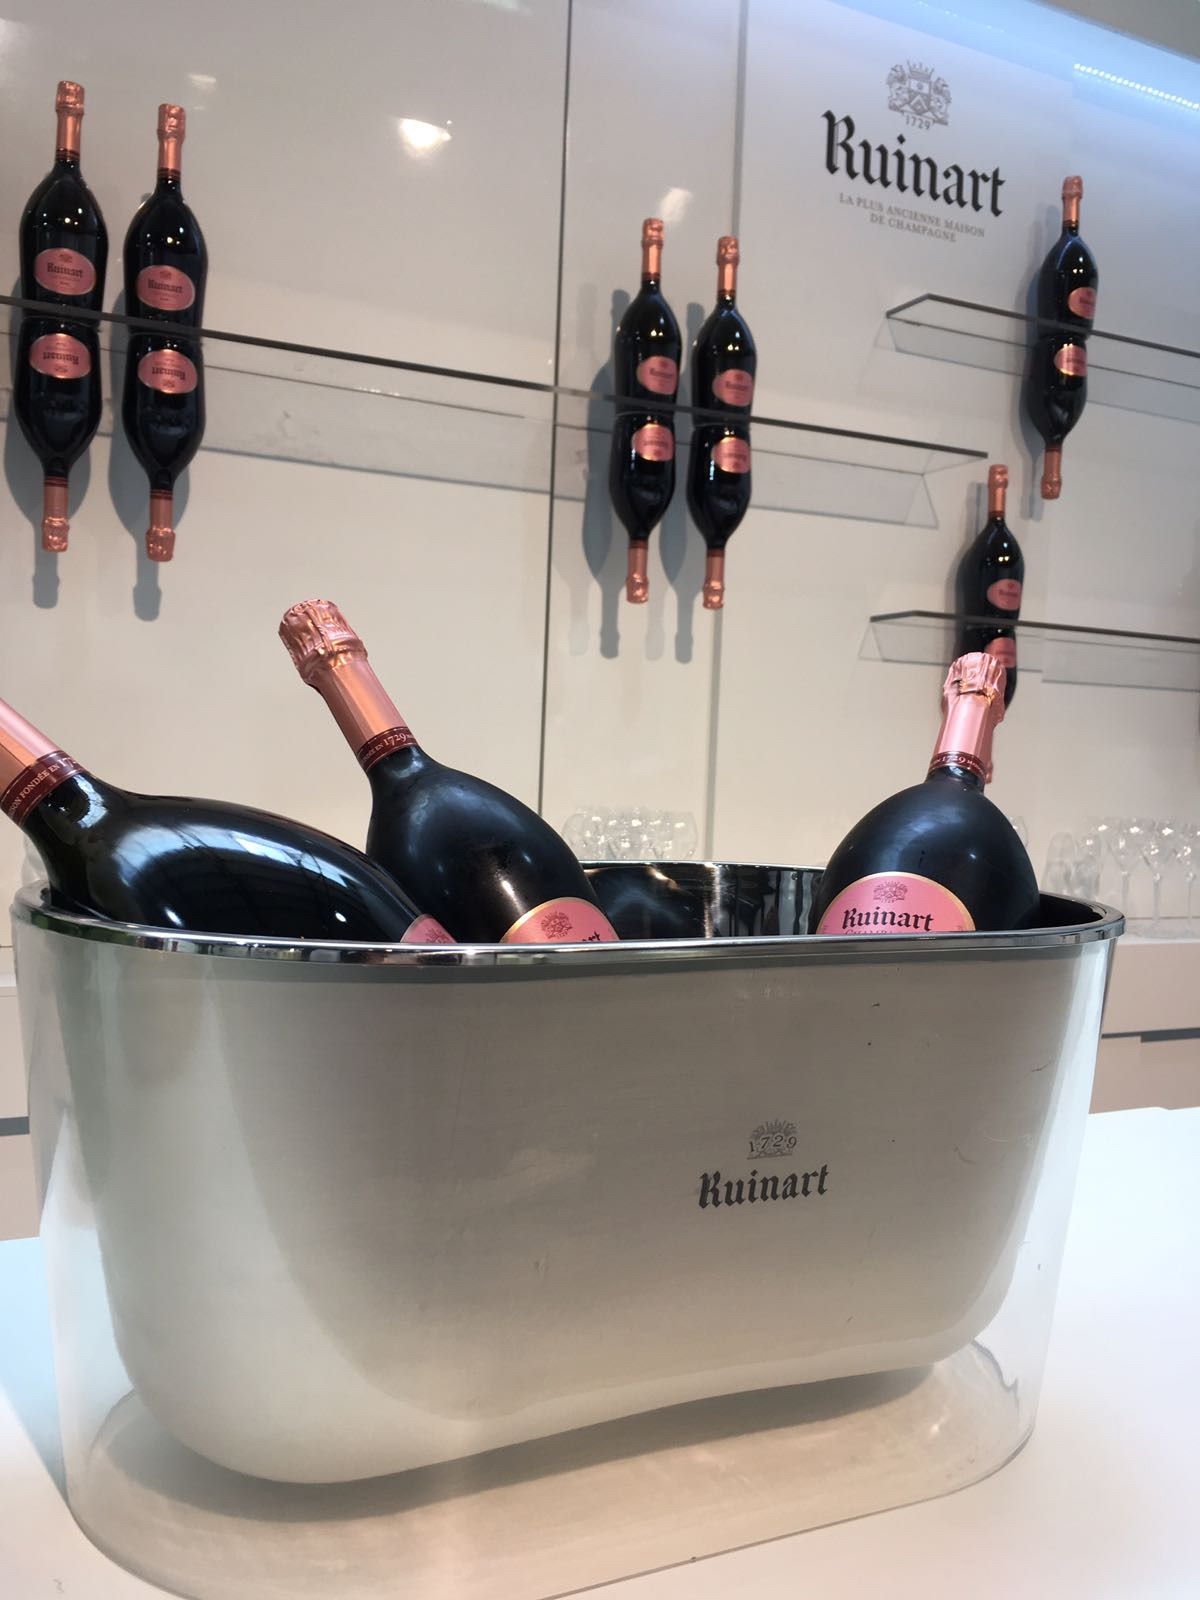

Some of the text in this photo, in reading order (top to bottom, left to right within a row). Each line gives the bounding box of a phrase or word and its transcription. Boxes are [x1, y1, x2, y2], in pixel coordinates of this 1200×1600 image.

[905, 114, 931, 131] 1729
[822, 110, 1006, 217] Ruinart
[840, 192, 986, 238] LA PLUS ANCIENNE MAISON
[870, 212, 956, 242] DE CHAMPAGNE
[383, 732, 407, 747] 1729
[20, 769, 50, 799] FONDÉE
[48, 763, 60, 773] EN
[842, 906, 934, 931] Ruinart
[749, 1134, 798, 1153] 1729
[699, 1164, 830, 1209] Ruinart
